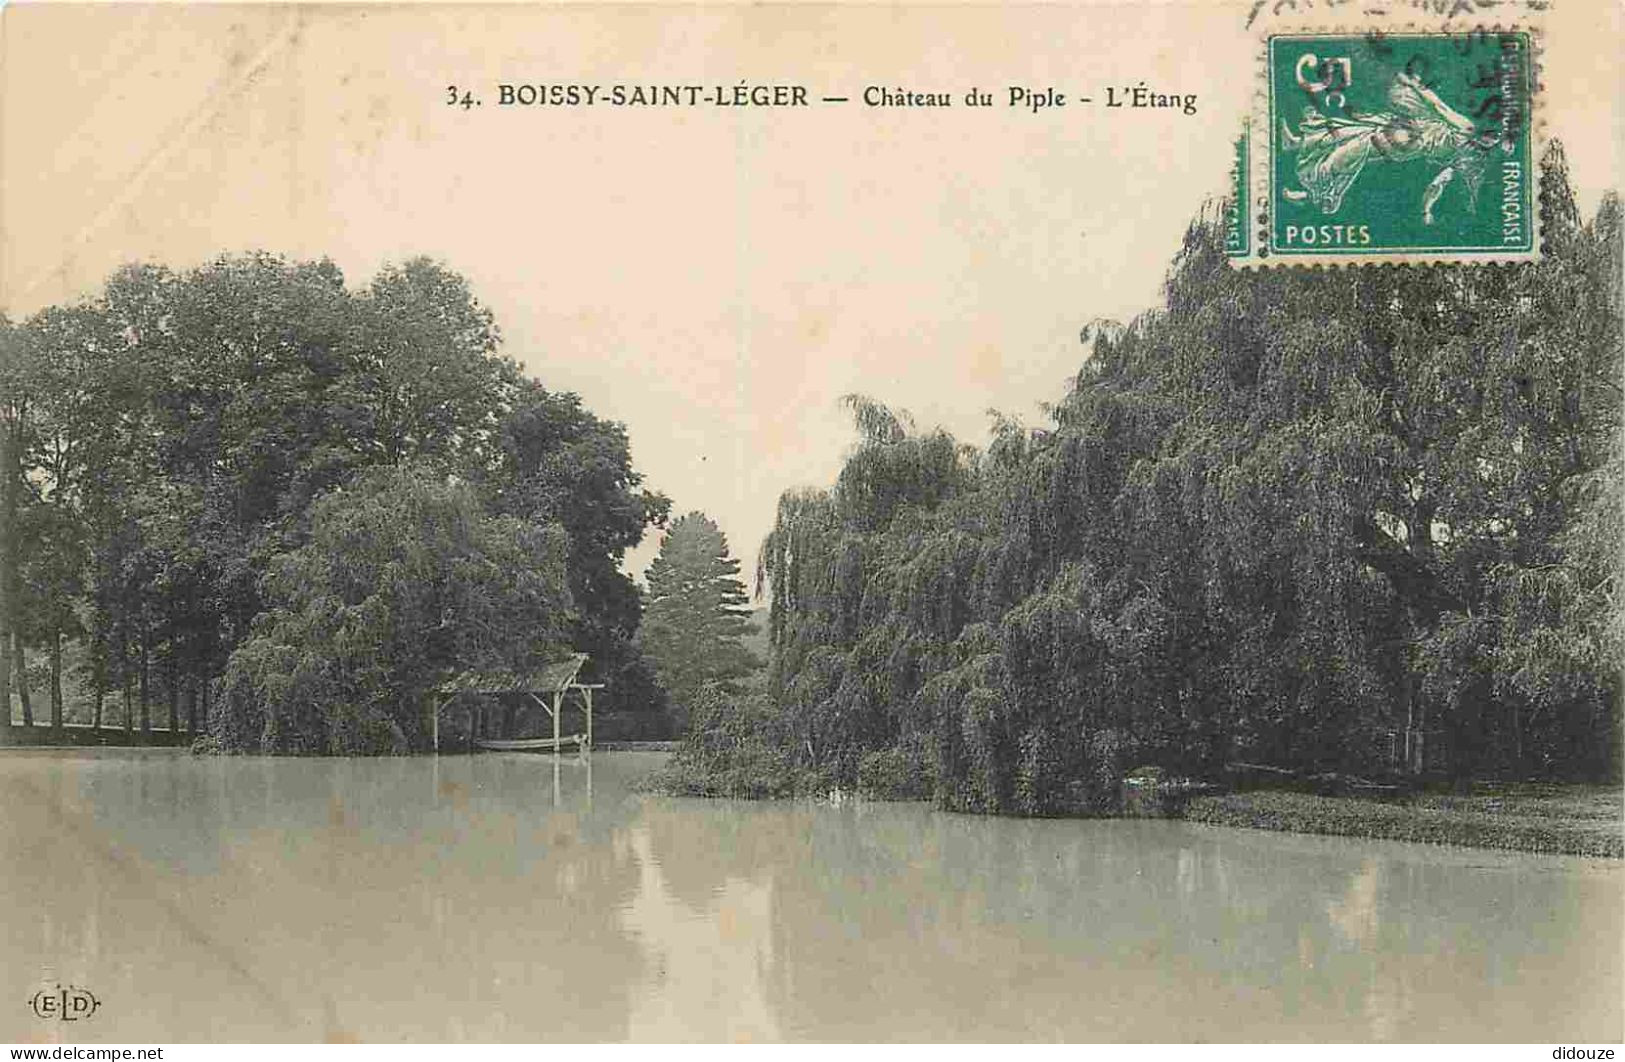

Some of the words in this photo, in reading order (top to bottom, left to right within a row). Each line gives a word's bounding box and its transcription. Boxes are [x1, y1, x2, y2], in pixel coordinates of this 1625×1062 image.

[446, 85, 481, 110] 34.
[498, 79, 808, 107] BOISSY-SAINT-LÉGER
[863, 86, 951, 107] Château
[964, 87, 993, 107] du
[1008, 87, 1066, 114] Piple
[1106, 81, 1198, 115] L'Étang
[1502, 161, 1522, 244] FRANÇAISE
[1286, 225, 1370, 244] POSTES
